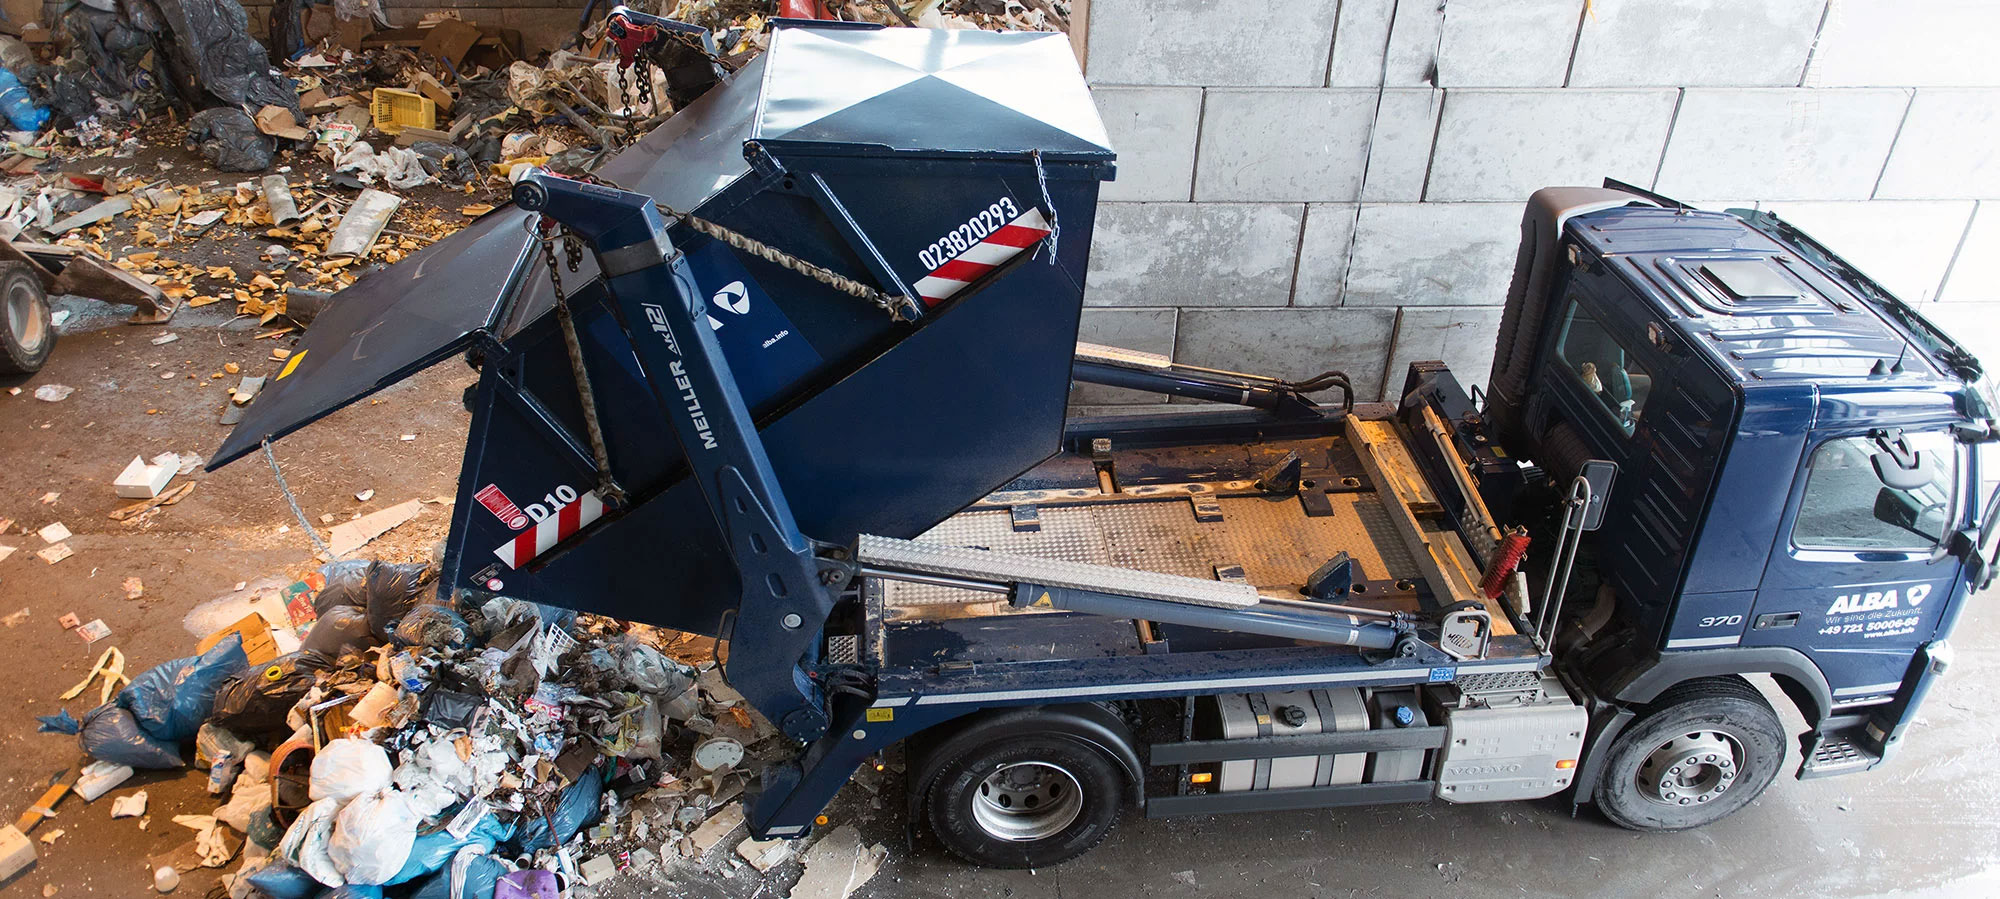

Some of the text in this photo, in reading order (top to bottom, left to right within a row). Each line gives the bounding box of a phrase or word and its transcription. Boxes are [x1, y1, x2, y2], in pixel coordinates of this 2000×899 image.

[918, 196, 1019, 271] 023820293
[762, 329, 789, 349] alba.info
[669, 359, 718, 450] MEILLER
[1825, 589, 1898, 615] ALBA
[1699, 614, 1743, 627] 370
[1825, 615, 1842, 625] Wir
[1844, 612, 1865, 623] sind
[1867, 610, 1883, 620] die
[1818, 625, 1842, 635] +49
[1842, 623, 1864, 633] 721
[1449, 763, 1522, 776] VOLVO
